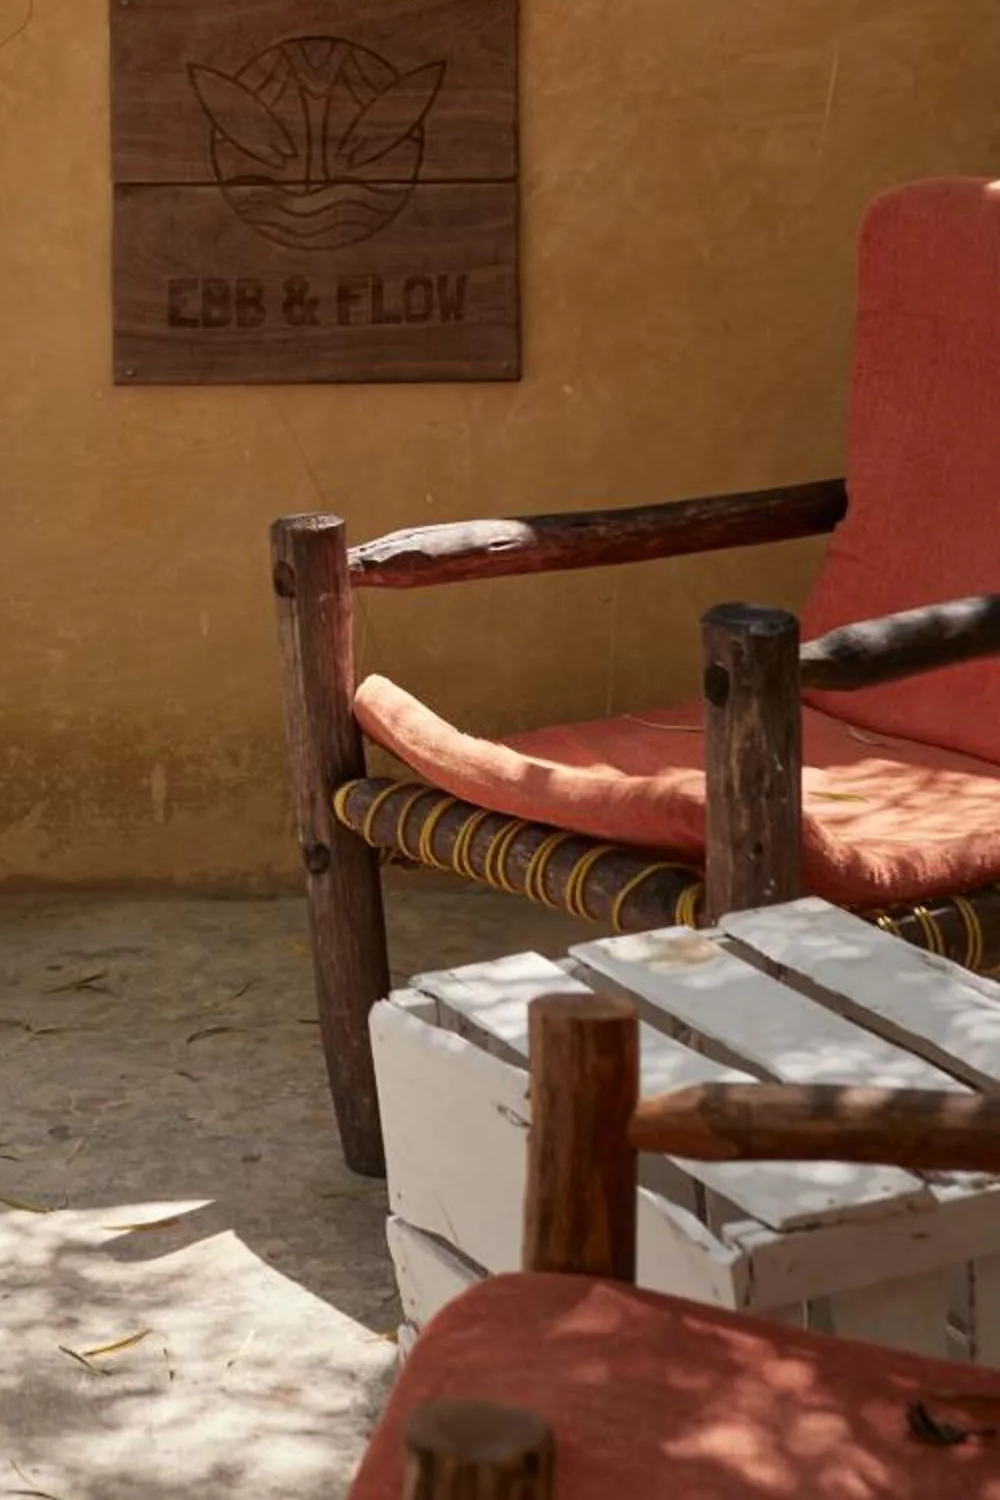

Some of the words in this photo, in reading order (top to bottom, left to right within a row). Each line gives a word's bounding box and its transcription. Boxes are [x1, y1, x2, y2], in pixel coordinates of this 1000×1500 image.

[167, 276, 267, 328] EBB
[282, 274, 320, 326] &
[336, 273, 467, 325] FLOW
